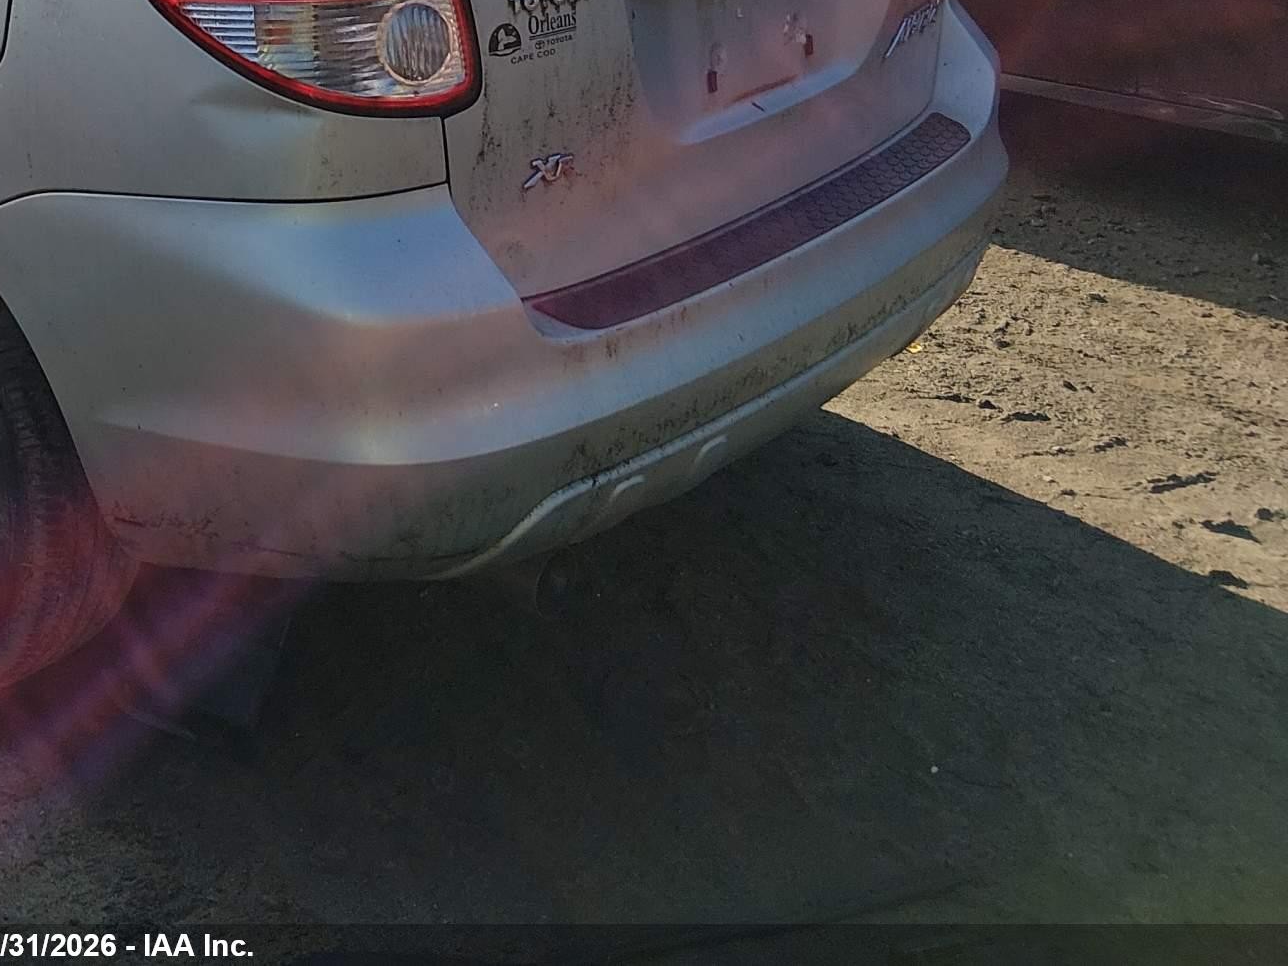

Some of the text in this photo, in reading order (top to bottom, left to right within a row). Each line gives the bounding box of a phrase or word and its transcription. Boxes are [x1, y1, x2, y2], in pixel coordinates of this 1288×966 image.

[528, 12, 577, 35] Orleans
[545, 34, 573, 46] TOYOTA
[510, 47, 556, 65] CAPE COD
